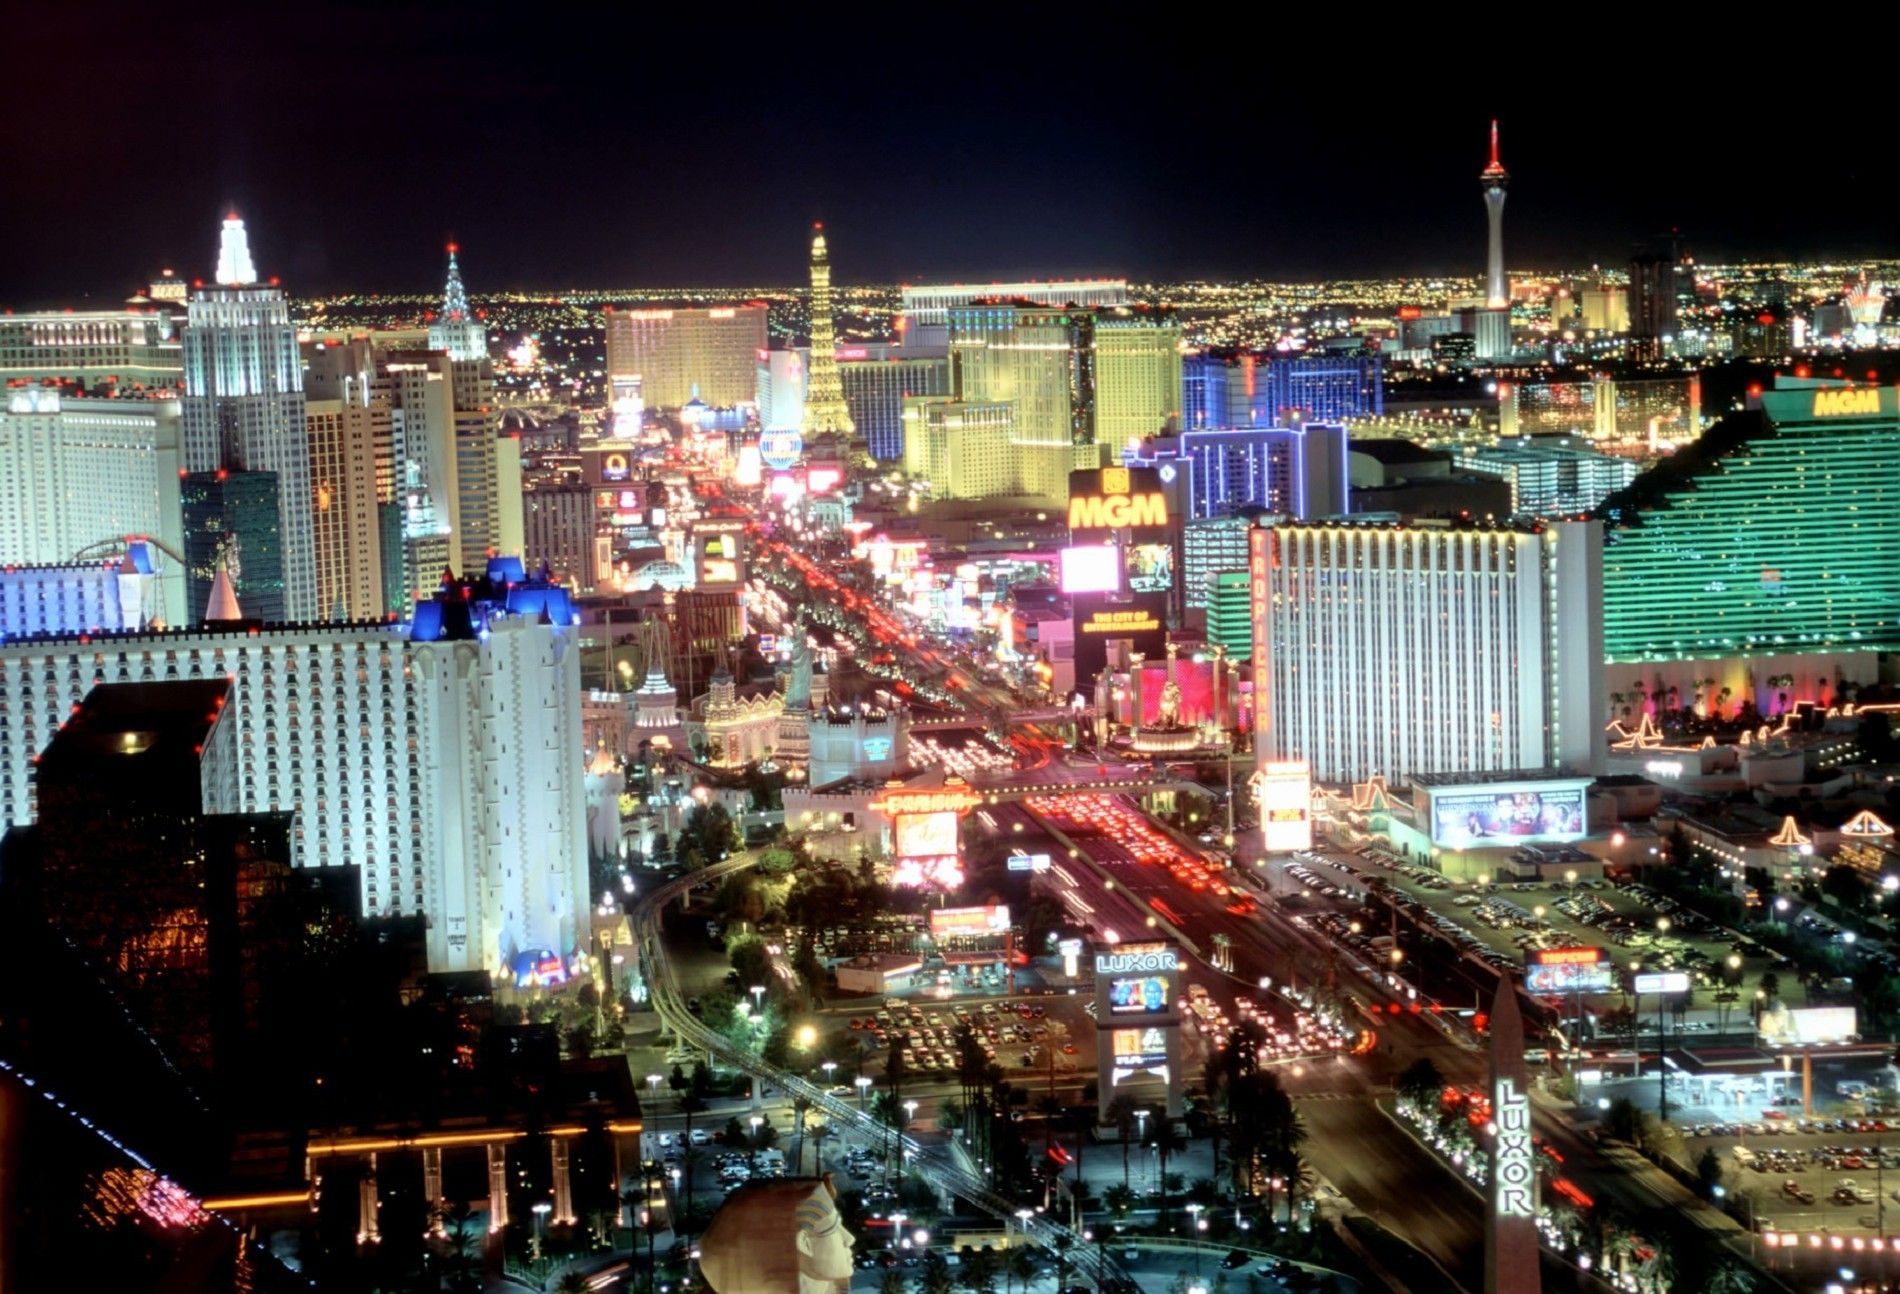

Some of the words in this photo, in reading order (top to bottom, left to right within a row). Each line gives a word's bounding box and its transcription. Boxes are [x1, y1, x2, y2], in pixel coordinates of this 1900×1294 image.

[1814, 389, 1880, 417] MGM
[1068, 493, 1168, 529] MGM
[1092, 612, 1112, 623] THE
[1113, 612, 1134, 622] CITY
[1253, 533, 1269, 732] TROPICANA
[1097, 953, 1177, 973] LUXOR
[1499, 1080, 1534, 1214] LUXOR
